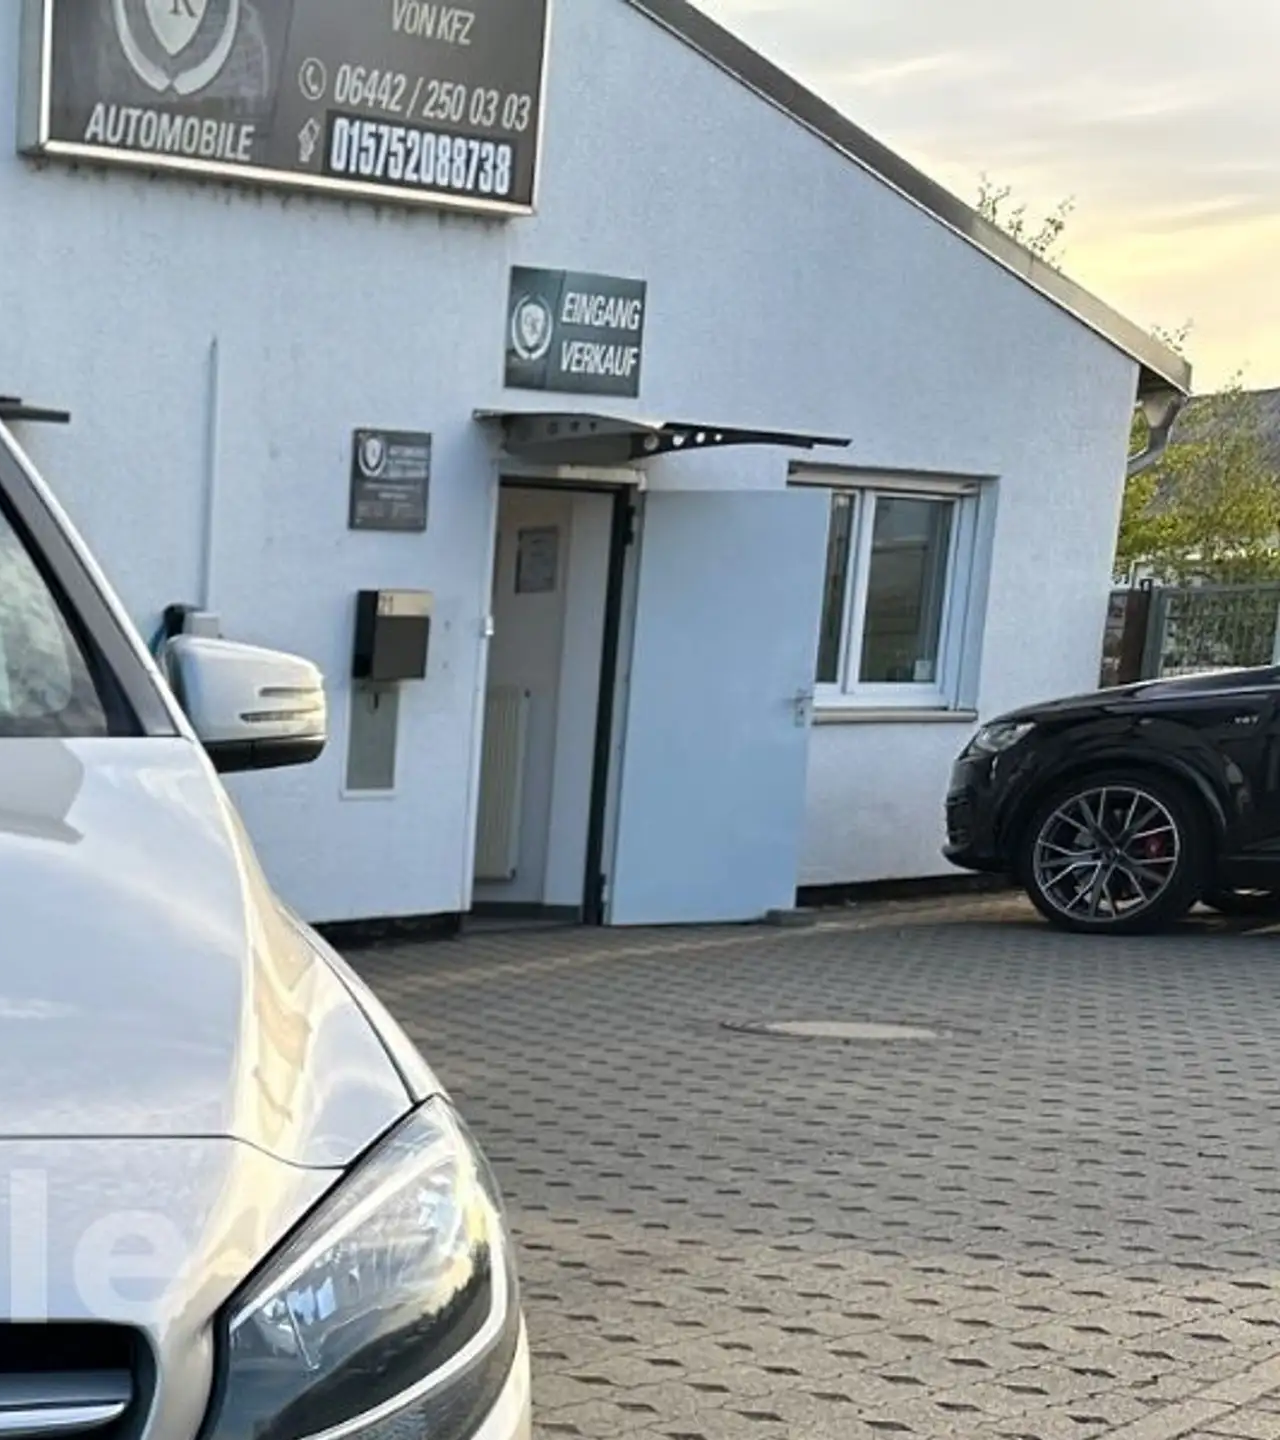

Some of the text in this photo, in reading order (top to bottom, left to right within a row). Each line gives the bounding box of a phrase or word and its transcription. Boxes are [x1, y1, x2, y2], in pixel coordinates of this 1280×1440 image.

[393, 0, 475, 45] VON KFZ
[334, 64, 407, 113] 06442
[422, 80, 466, 123] 250
[469, 88, 500, 127] 03
[502, 93, 532, 133] 03
[85, 102, 255, 161] AUTOMOBILE
[330, 117, 512, 196] 015752088738
[561, 291, 641, 331] EINGANG
[560, 340, 639, 378] VERKAUF
